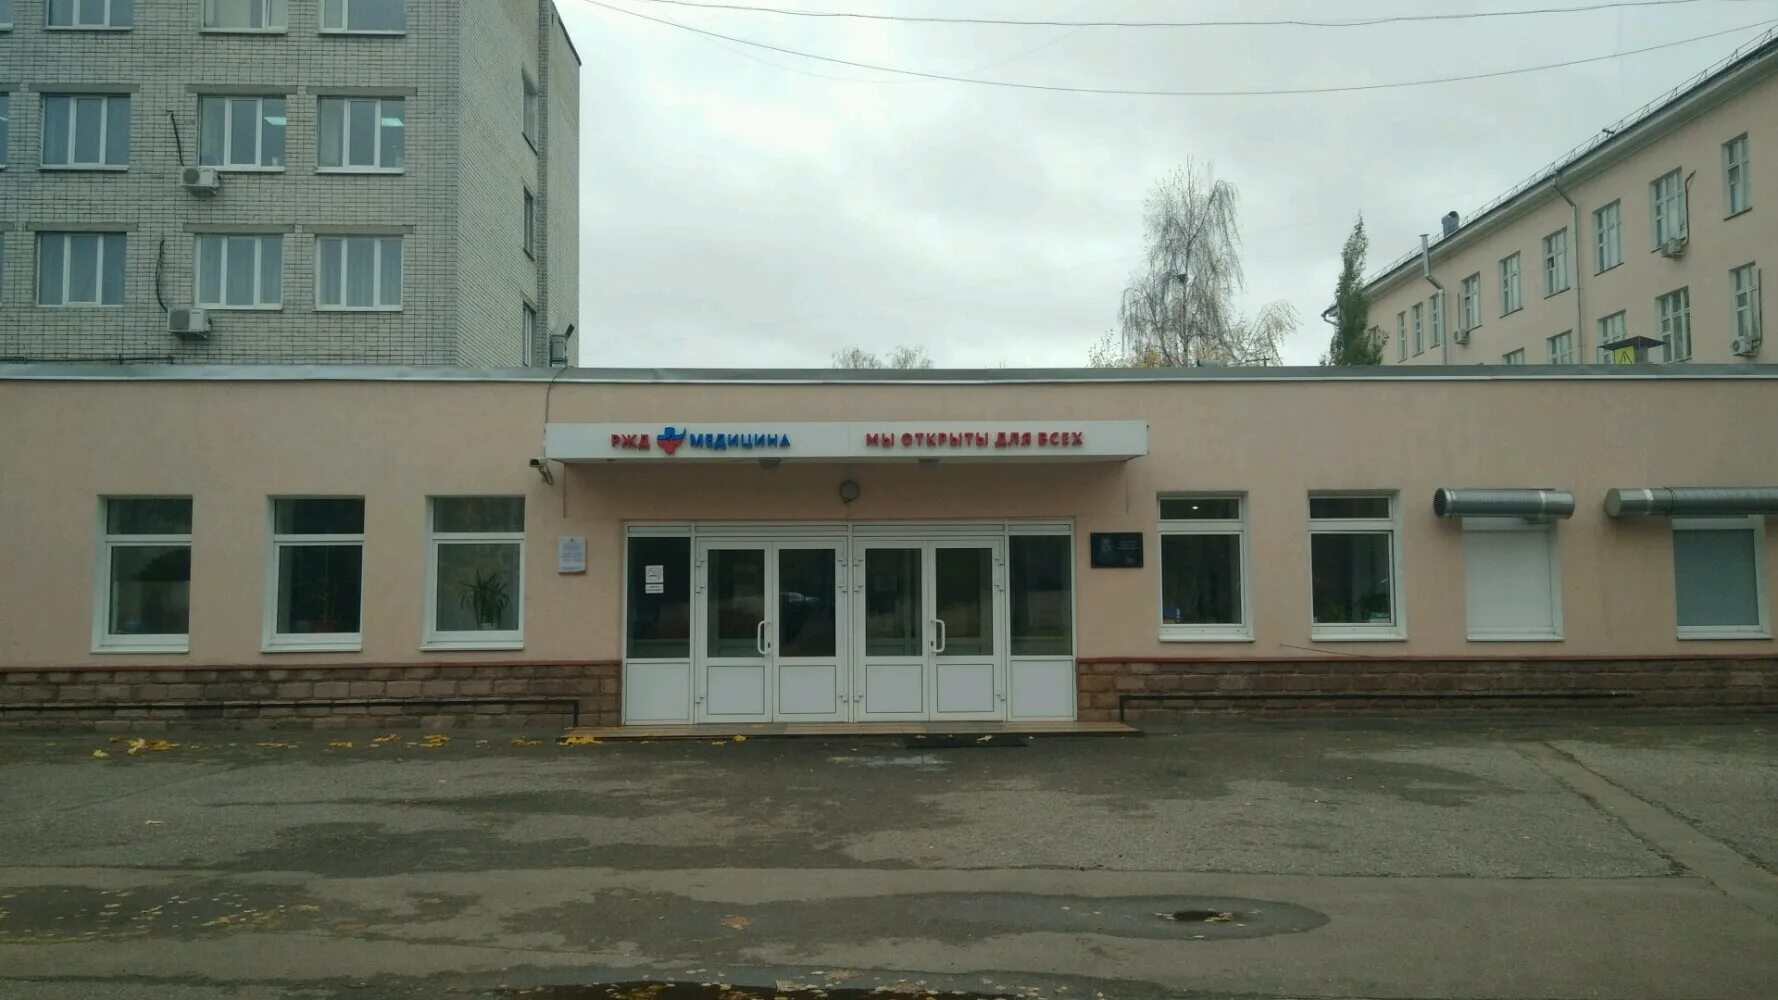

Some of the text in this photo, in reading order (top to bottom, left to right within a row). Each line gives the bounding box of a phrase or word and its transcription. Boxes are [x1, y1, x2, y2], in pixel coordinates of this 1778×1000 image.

[611, 433, 791, 450] РЖД МЕДИЦИНА
[865, 432, 1084, 448] МЫ ОТКРЫТЫ ДЛЯ ВСЕХ
